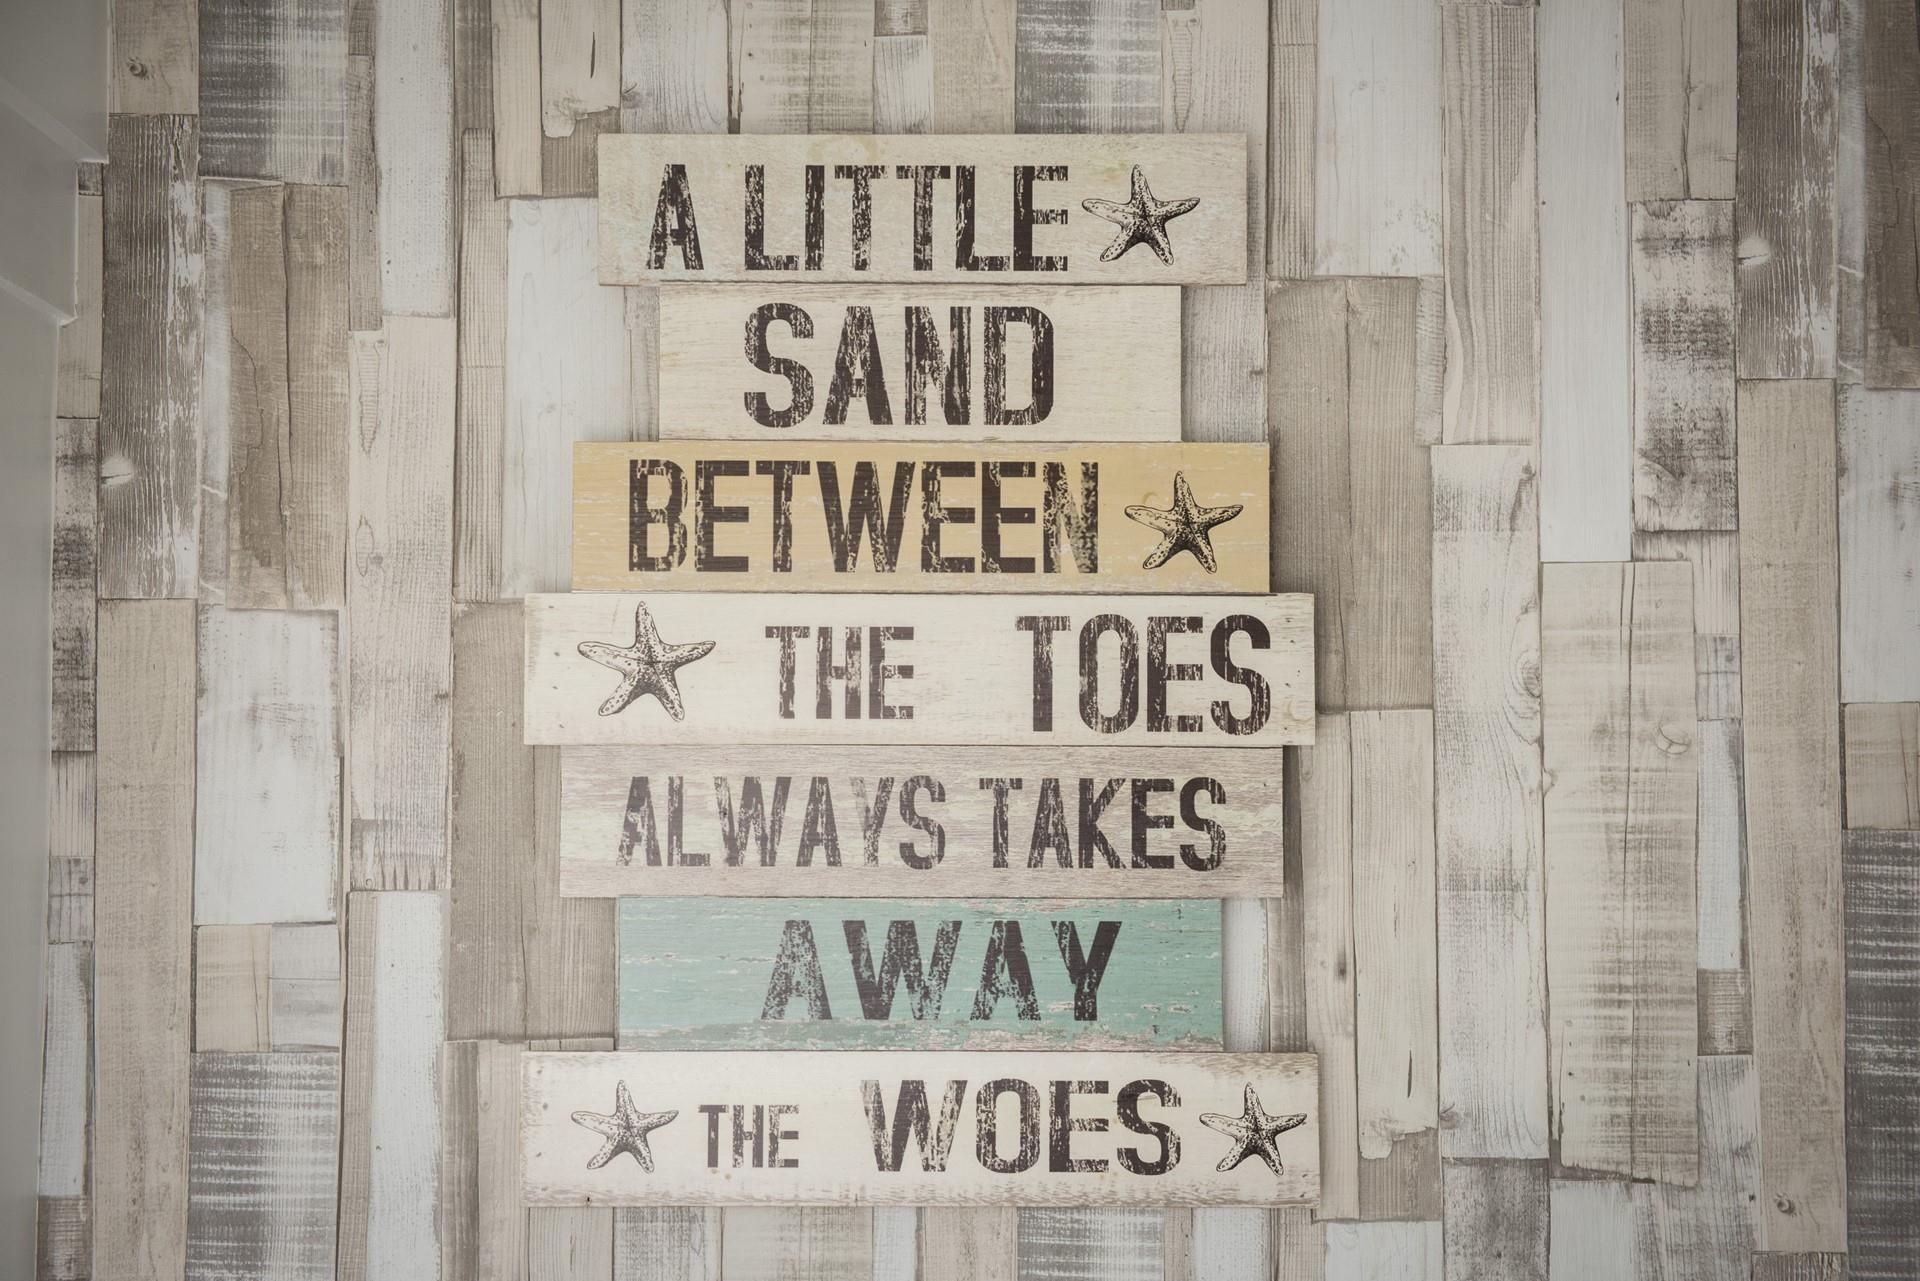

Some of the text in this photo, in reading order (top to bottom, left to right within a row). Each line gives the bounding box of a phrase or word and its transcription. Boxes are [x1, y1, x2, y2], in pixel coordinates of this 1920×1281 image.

[646, 164, 1069, 272] A LITTLE
[744, 303, 1055, 429] SAND
[629, 460, 1099, 574] BETWEEN
[766, 614, 1271, 736] THE TOES
[617, 775, 1227, 872] ALWAYS TAKES
[762, 919, 1123, 1022] AWAY
[699, 1079, 1182, 1176] THE WOES
